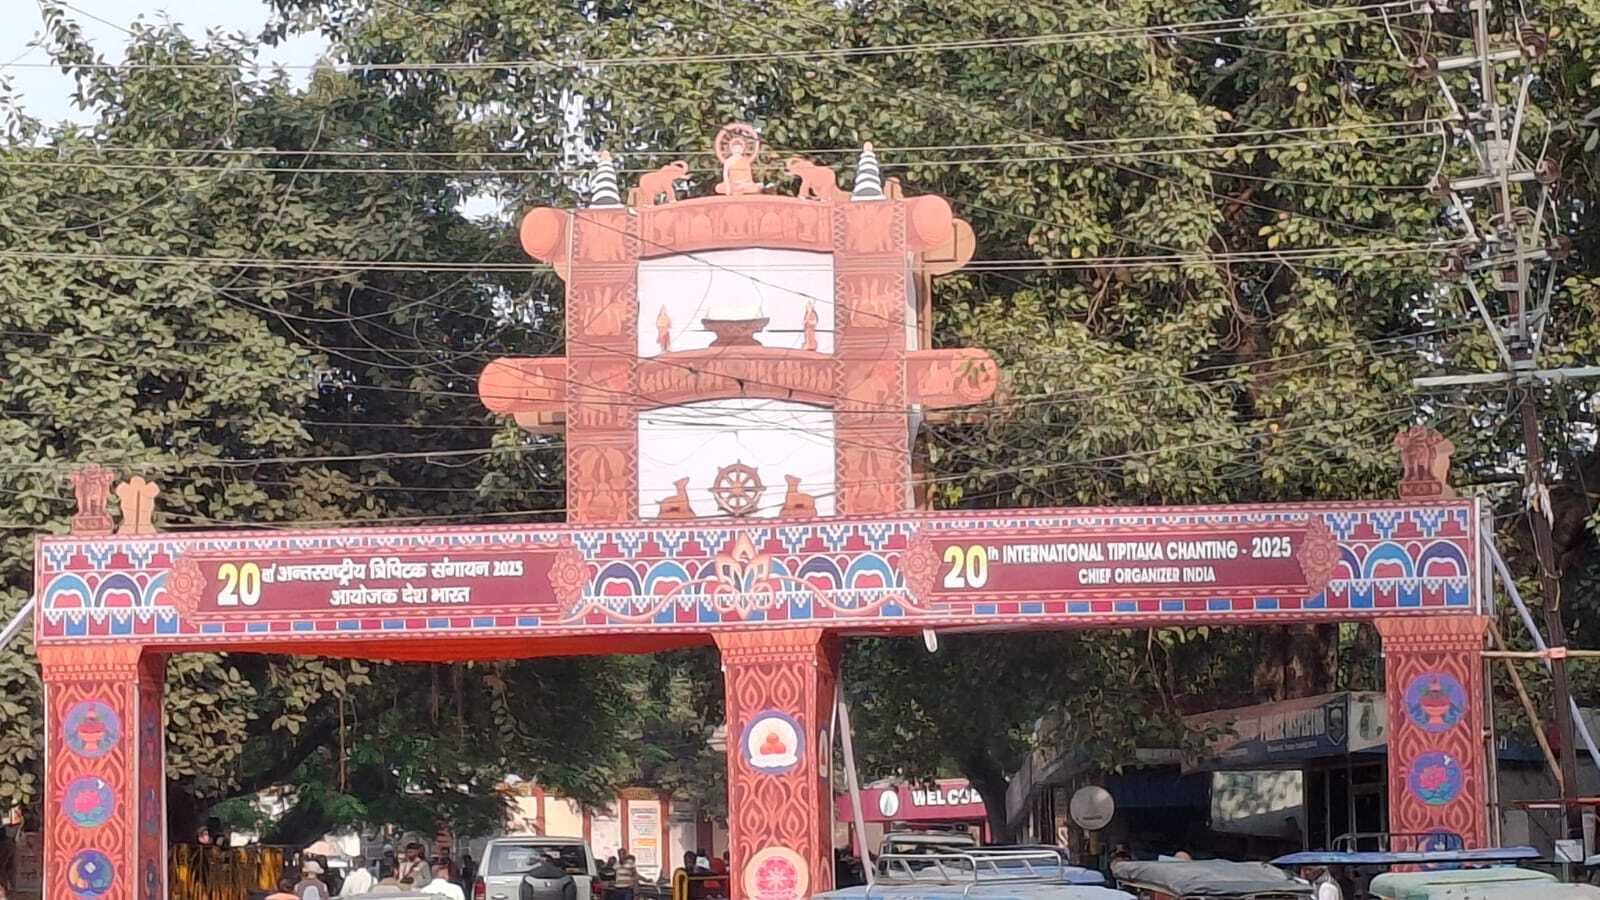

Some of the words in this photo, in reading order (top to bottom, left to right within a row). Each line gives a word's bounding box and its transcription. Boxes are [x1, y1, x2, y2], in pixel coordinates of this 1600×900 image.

[1003, 543, 1104, 563] INTERNATIONAL
[1106, 541, 1163, 561] TIPITAKA
[1167, 539, 1238, 559] CHANTING
[1251, 536, 1291, 557] 2025
[369, 557, 428, 580] त्रिपिटक
[430, 556, 490, 578] संगायन
[493, 560, 523, 577] 2025
[1078, 568, 1111, 584] CHIEF
[1115, 567, 1180, 583] ORGANIZER
[1183, 566, 1217, 582] INDIA
[329, 583, 399, 606] आयोजक
[401, 582, 428, 603] देश
[431, 586, 471, 603] भारत
